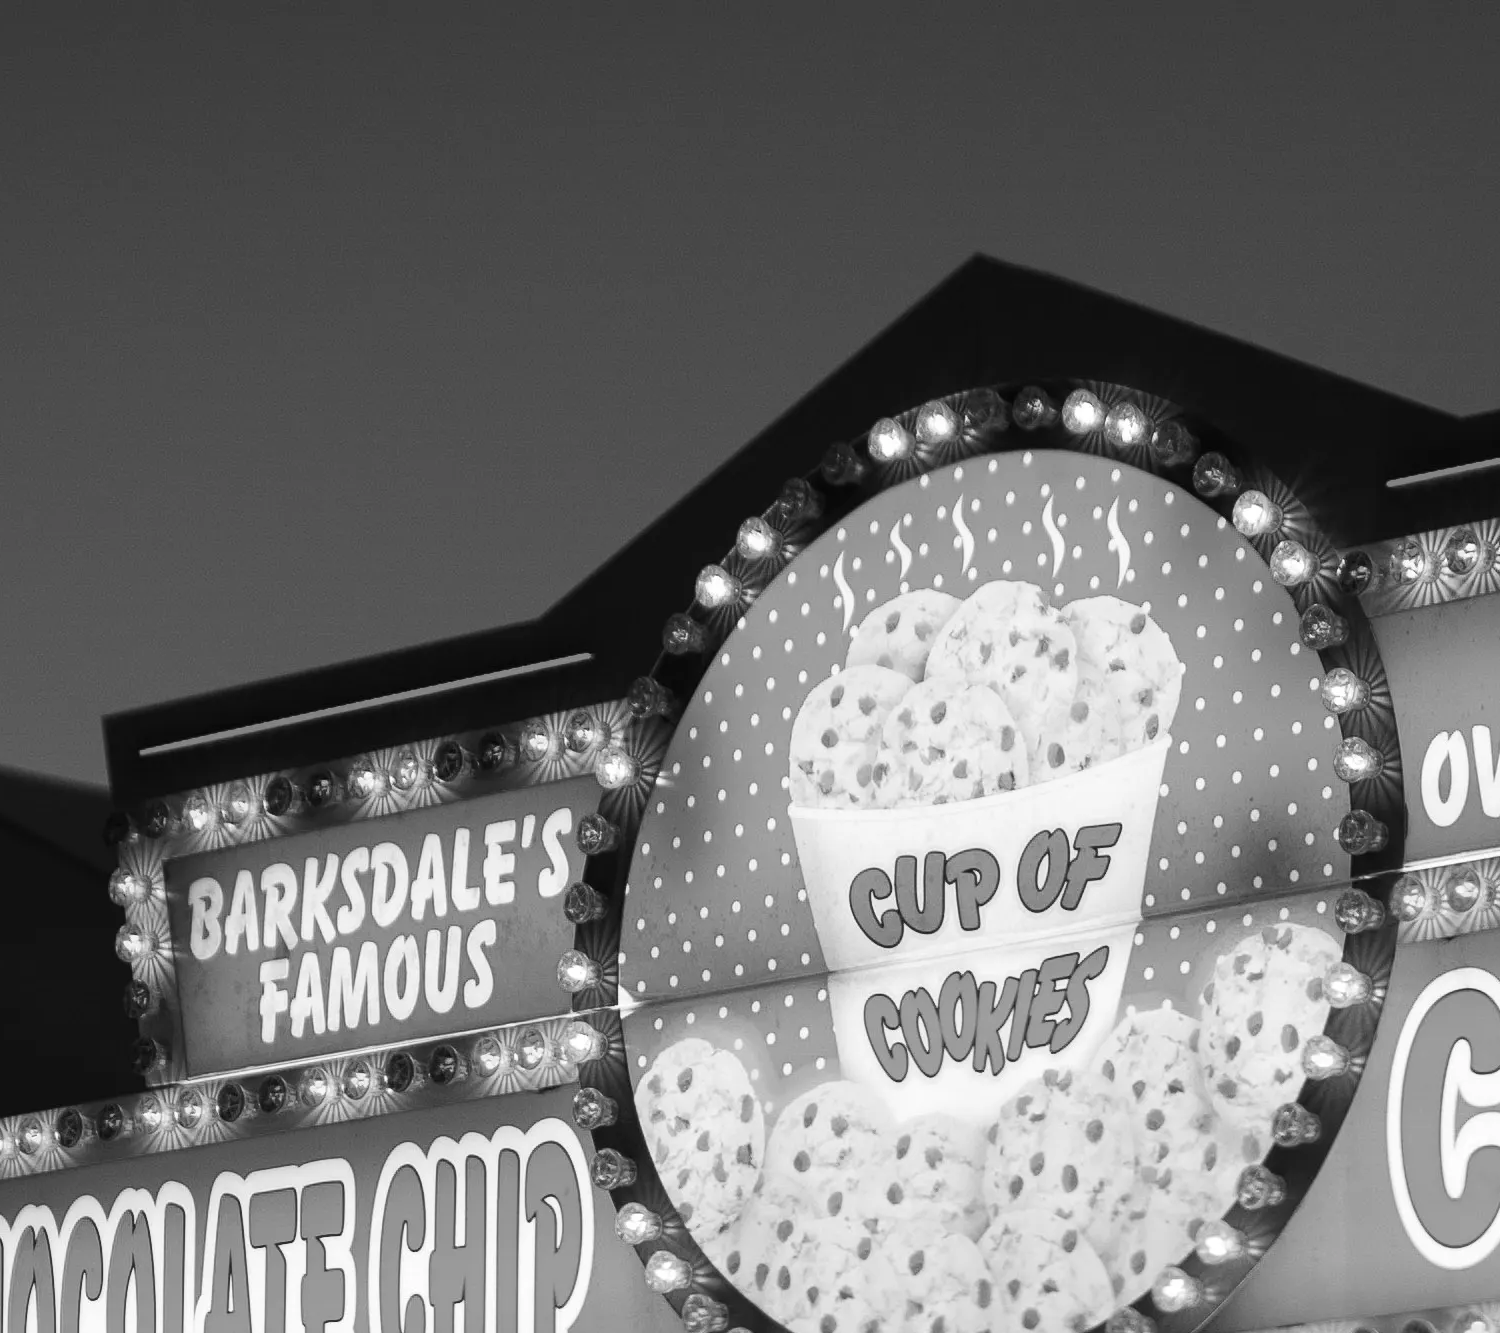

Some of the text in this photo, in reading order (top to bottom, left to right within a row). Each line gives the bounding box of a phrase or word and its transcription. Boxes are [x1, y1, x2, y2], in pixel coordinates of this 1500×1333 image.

[187, 807, 573, 960] BARKSDALE'S
[848, 821, 1122, 949] CUP OF
[259, 920, 496, 1044] FAMOUS
[862, 945, 1110, 1083] COOKIES
